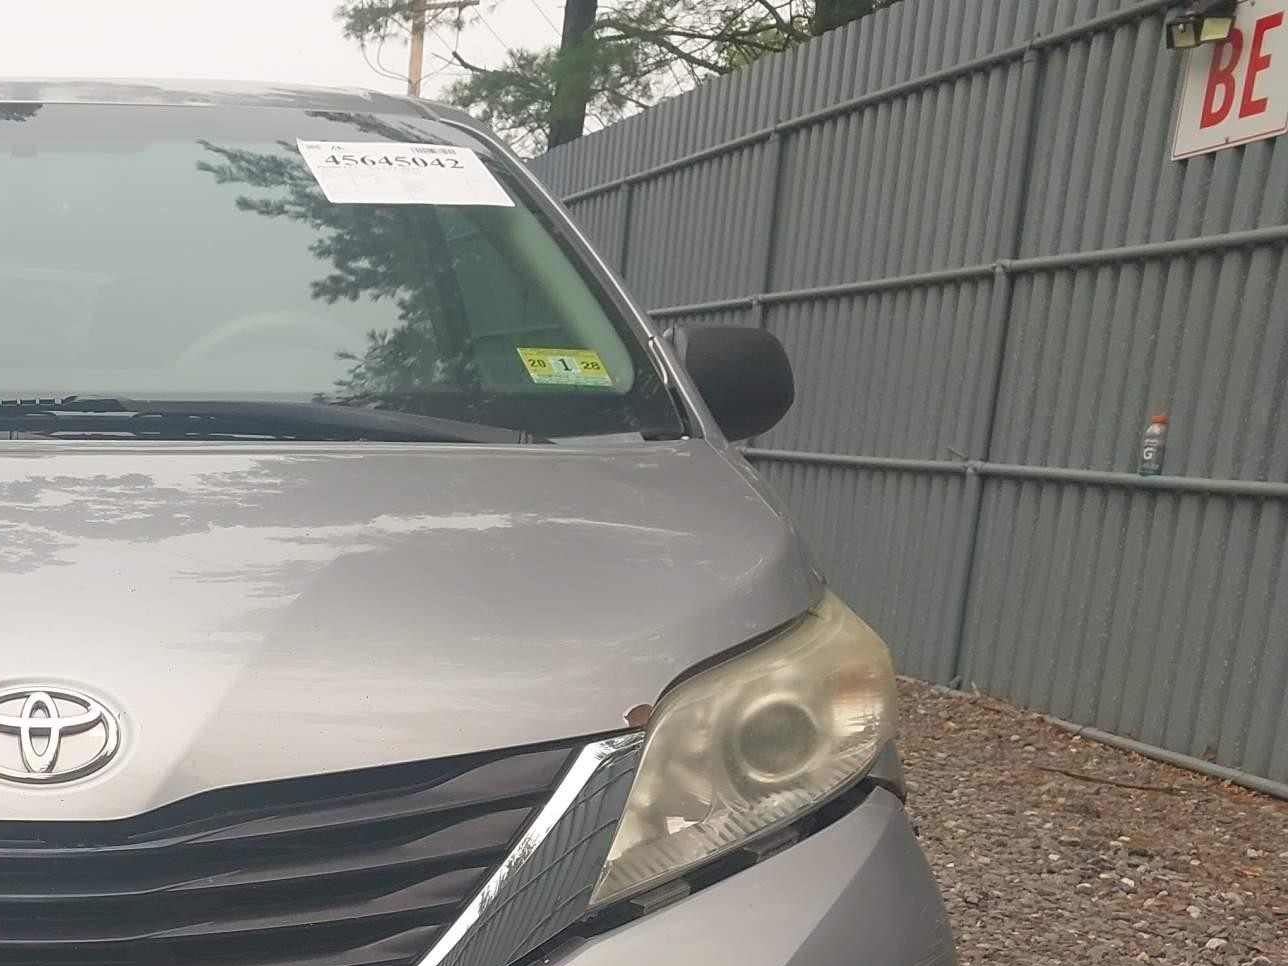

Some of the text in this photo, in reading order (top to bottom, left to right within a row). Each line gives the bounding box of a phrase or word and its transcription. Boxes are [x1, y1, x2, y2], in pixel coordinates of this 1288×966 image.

[1200, 11, 1285, 130] BE
[325, 154, 465, 170] 45645042
[528, 358, 601, 371] 20 1 28
